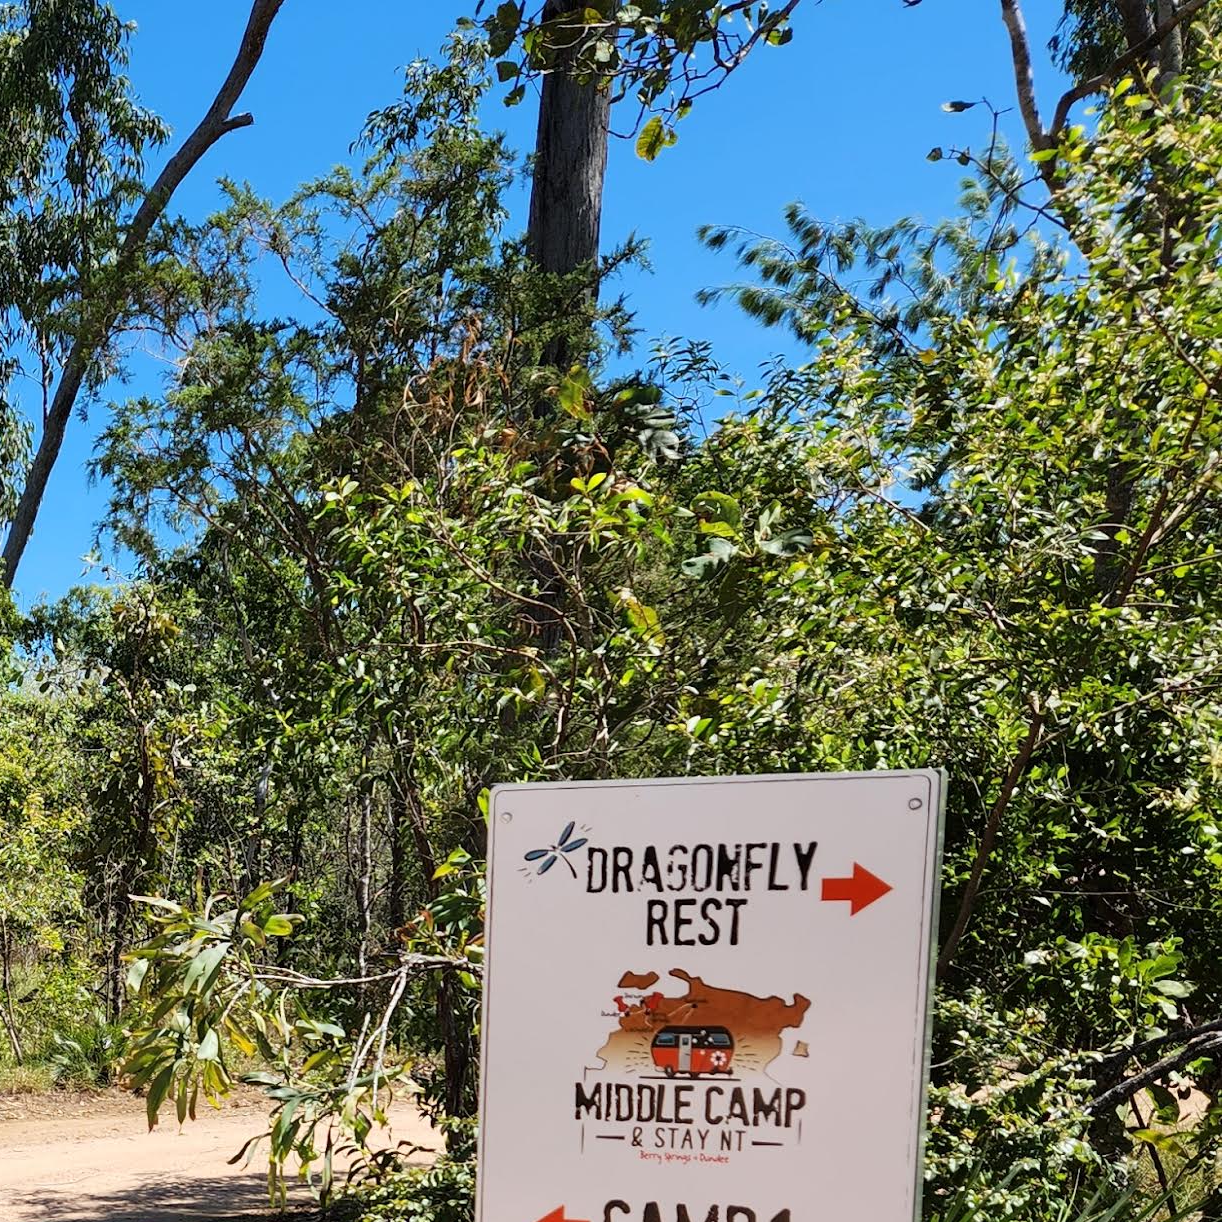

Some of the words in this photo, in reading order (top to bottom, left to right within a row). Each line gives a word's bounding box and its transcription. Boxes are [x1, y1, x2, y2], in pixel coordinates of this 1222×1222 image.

[585, 841, 818, 893] DRAGONFLY
[646, 897, 748, 946] REST
[574, 1082, 695, 1125] MIDDLE
[704, 1086, 807, 1128] CAMP
[631, 1126, 643, 1147] &
[654, 1126, 710, 1150] STAY
[720, 1130, 747, 1152] NT
